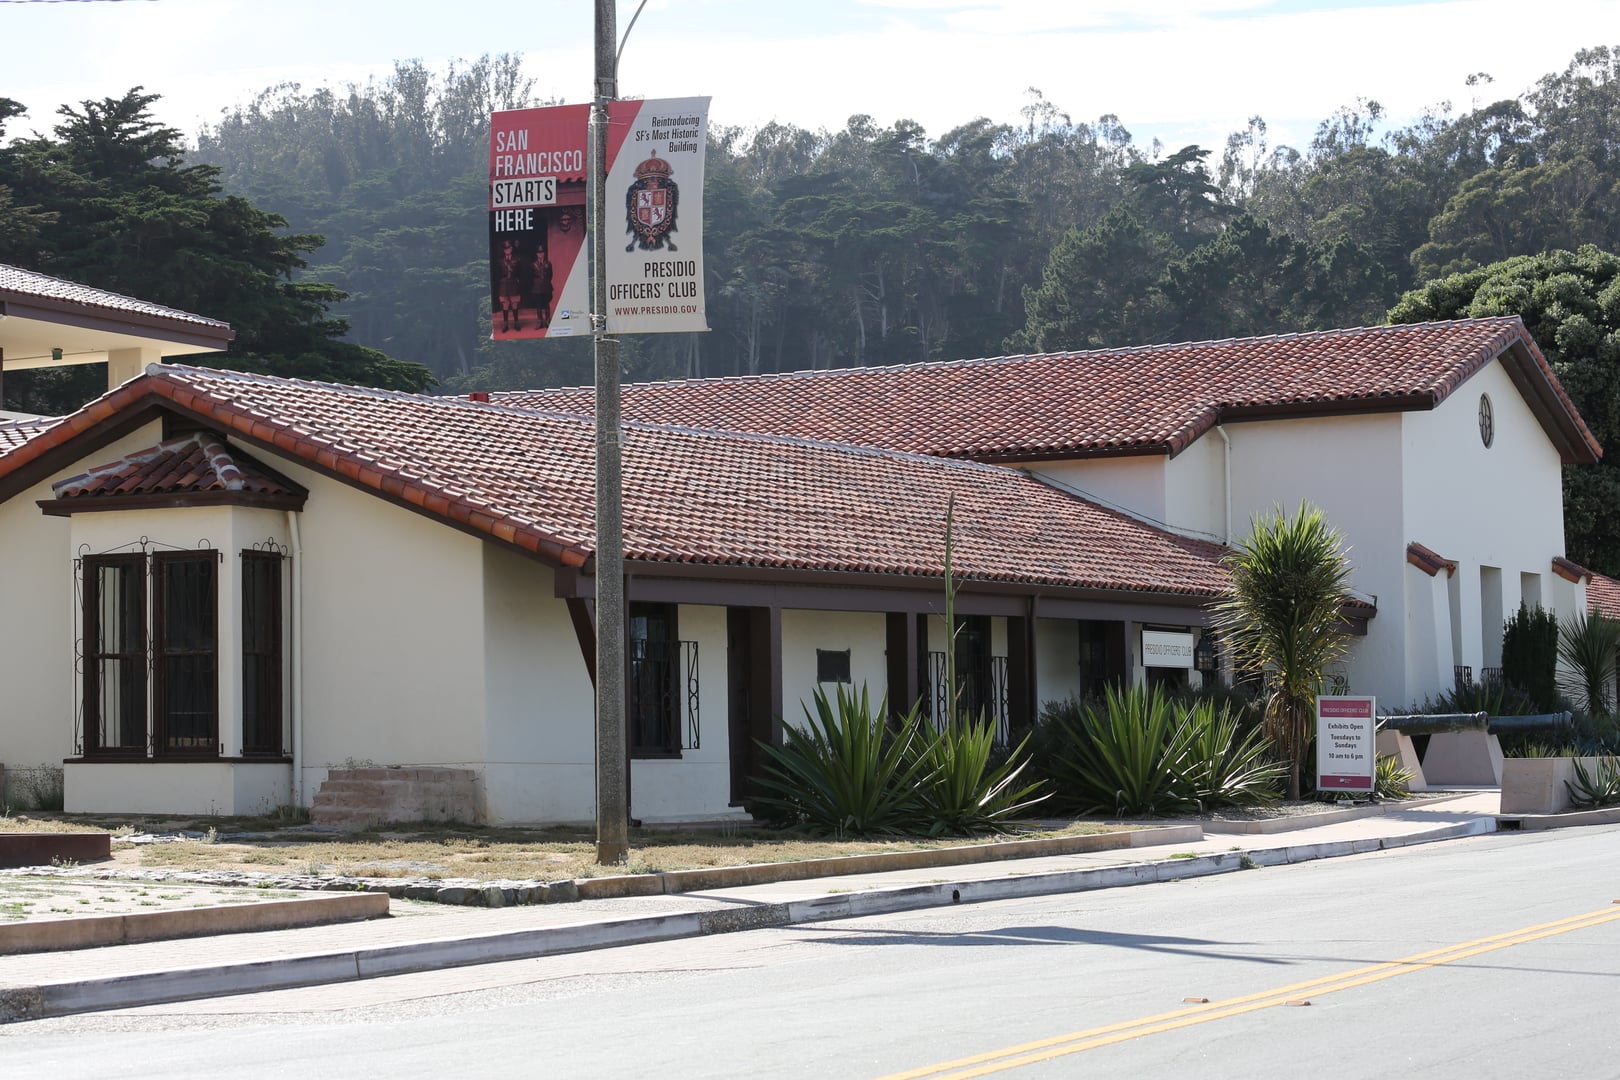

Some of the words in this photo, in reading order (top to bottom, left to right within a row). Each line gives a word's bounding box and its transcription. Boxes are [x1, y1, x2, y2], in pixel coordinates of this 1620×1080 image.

[651, 114, 700, 127] Reintroducing
[496, 129, 528, 152] SAN
[635, 130, 650, 142] SF's
[652, 129, 669, 141] Most
[671, 127, 699, 139] Historic
[668, 141, 698, 154] Building
[495, 150, 582, 177] FRANCISCO
[495, 179, 553, 204] STARTS
[495, 208, 534, 232] HERE
[644, 260, 696, 278] PRESIDIO
[610, 282, 664, 300] OFFICERS'
[668, 281, 697, 298] CLUB
[614, 305, 697, 316] WWW.PRESIDIO.GOV
[1350, 723, 1364, 731] Open
